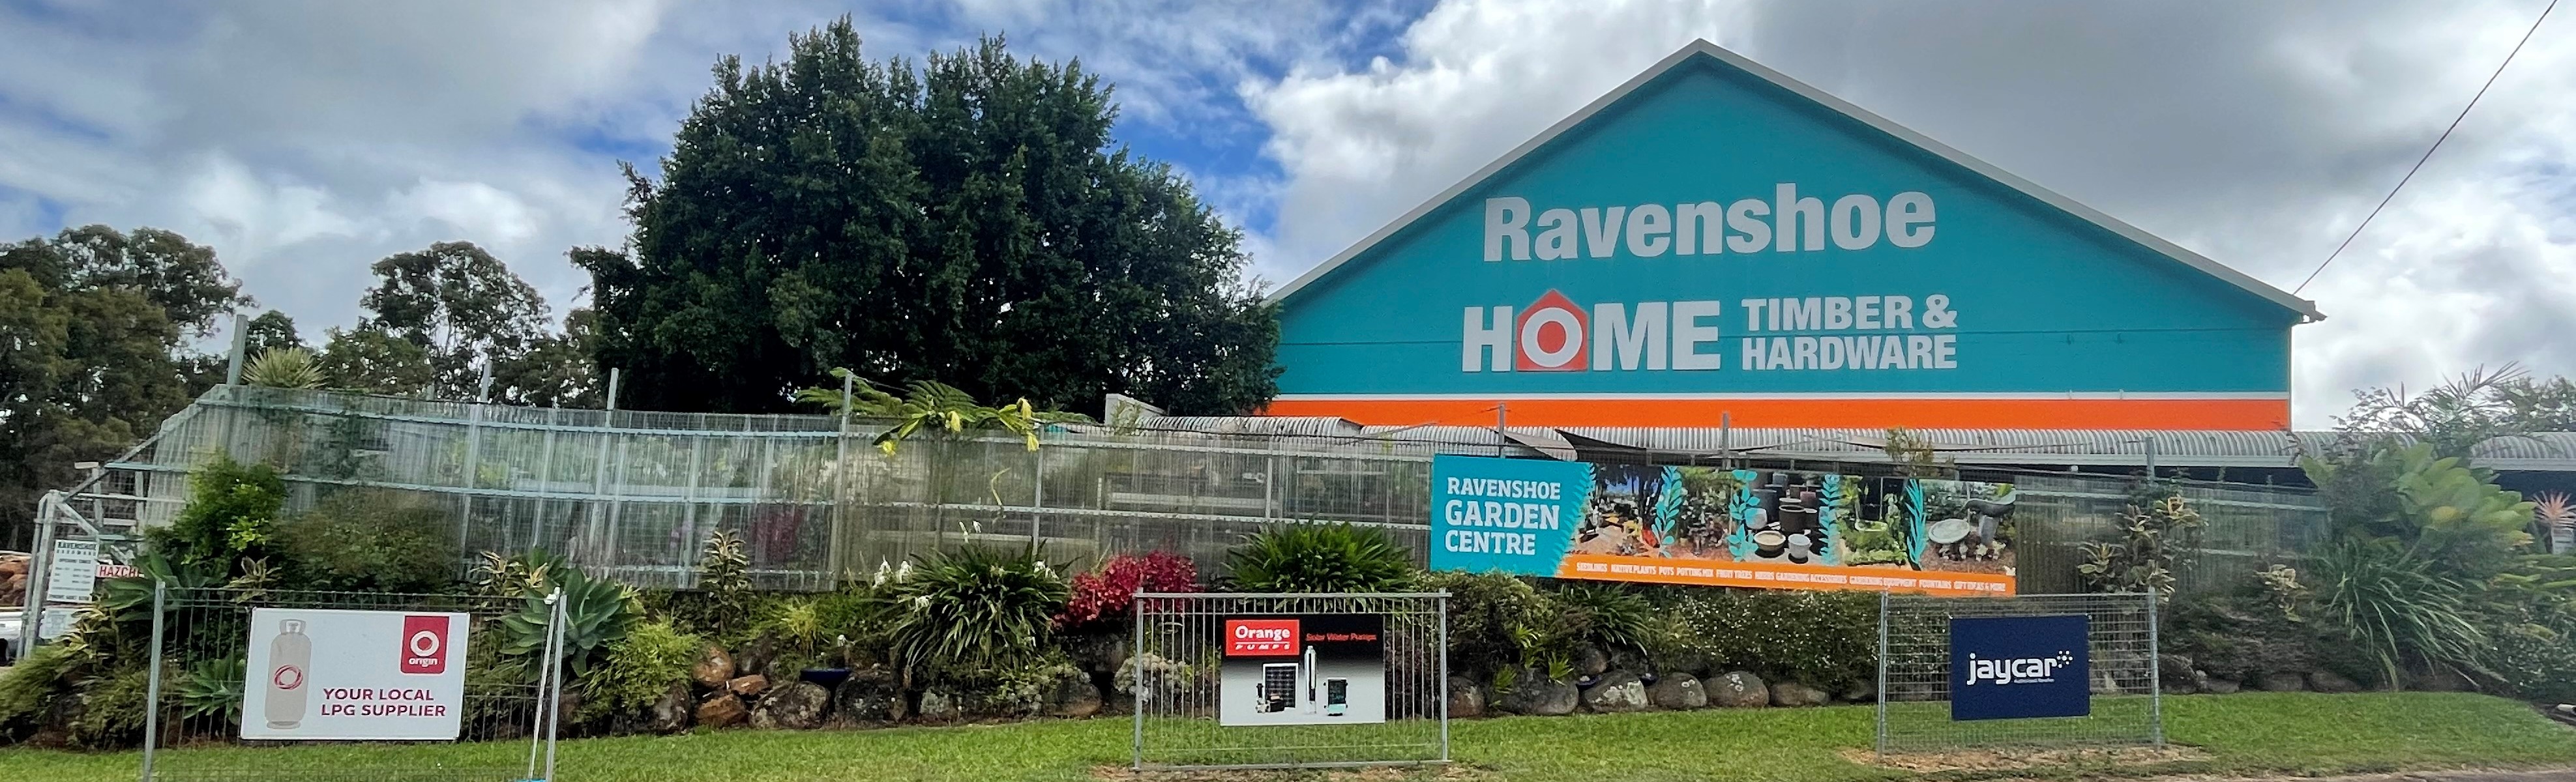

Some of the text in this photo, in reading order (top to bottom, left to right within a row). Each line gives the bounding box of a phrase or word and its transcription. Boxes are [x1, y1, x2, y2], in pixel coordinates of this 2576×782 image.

[1483, 182, 1936, 262] Ravenshoe
[1741, 293, 1958, 332] TIMBER &
[1462, 299, 1721, 373] HOME
[1741, 334, 1957, 371] HARDWARE
[1447, 476, 1562, 500] RAVENSHOE
[1445, 500, 1560, 530] GARDEN
[1445, 530, 1536, 555] CENTRE
[1659, 566, 1674, 575] POTS
[1235, 625, 1290, 641] Orange
[408, 658, 438, 667] origin
[1966, 652, 2058, 686] jaycar
[323, 688, 434, 701] YOUR LOCAL
[321, 704, 446, 717] LPG SUPPLIER
